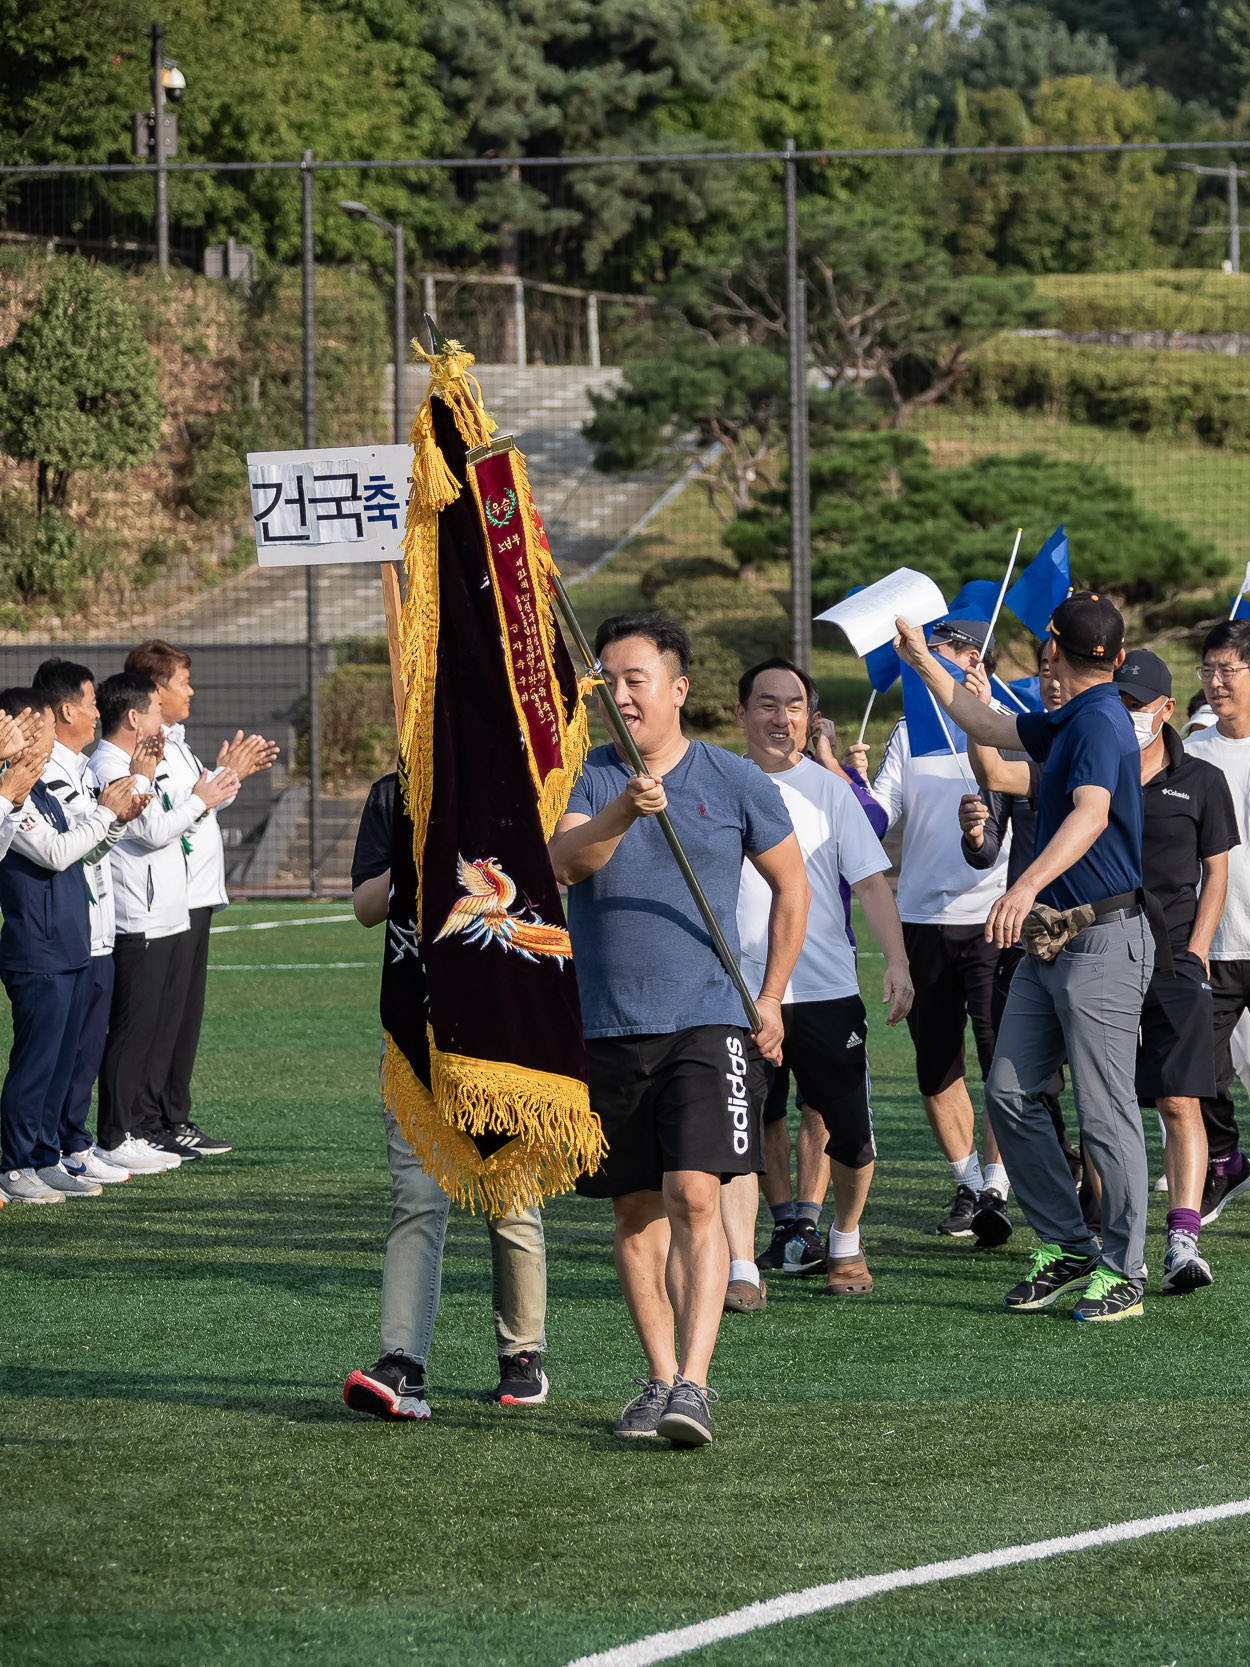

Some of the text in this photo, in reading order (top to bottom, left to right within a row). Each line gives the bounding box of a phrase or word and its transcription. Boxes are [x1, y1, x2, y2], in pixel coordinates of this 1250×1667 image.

[252, 472, 414, 542] 건국축
[491, 498, 511, 516] 우승
[1166, 789, 1190, 801] Columbia
[845, 1037, 864, 1049] adidas
[726, 1036, 749, 1155] adidas
